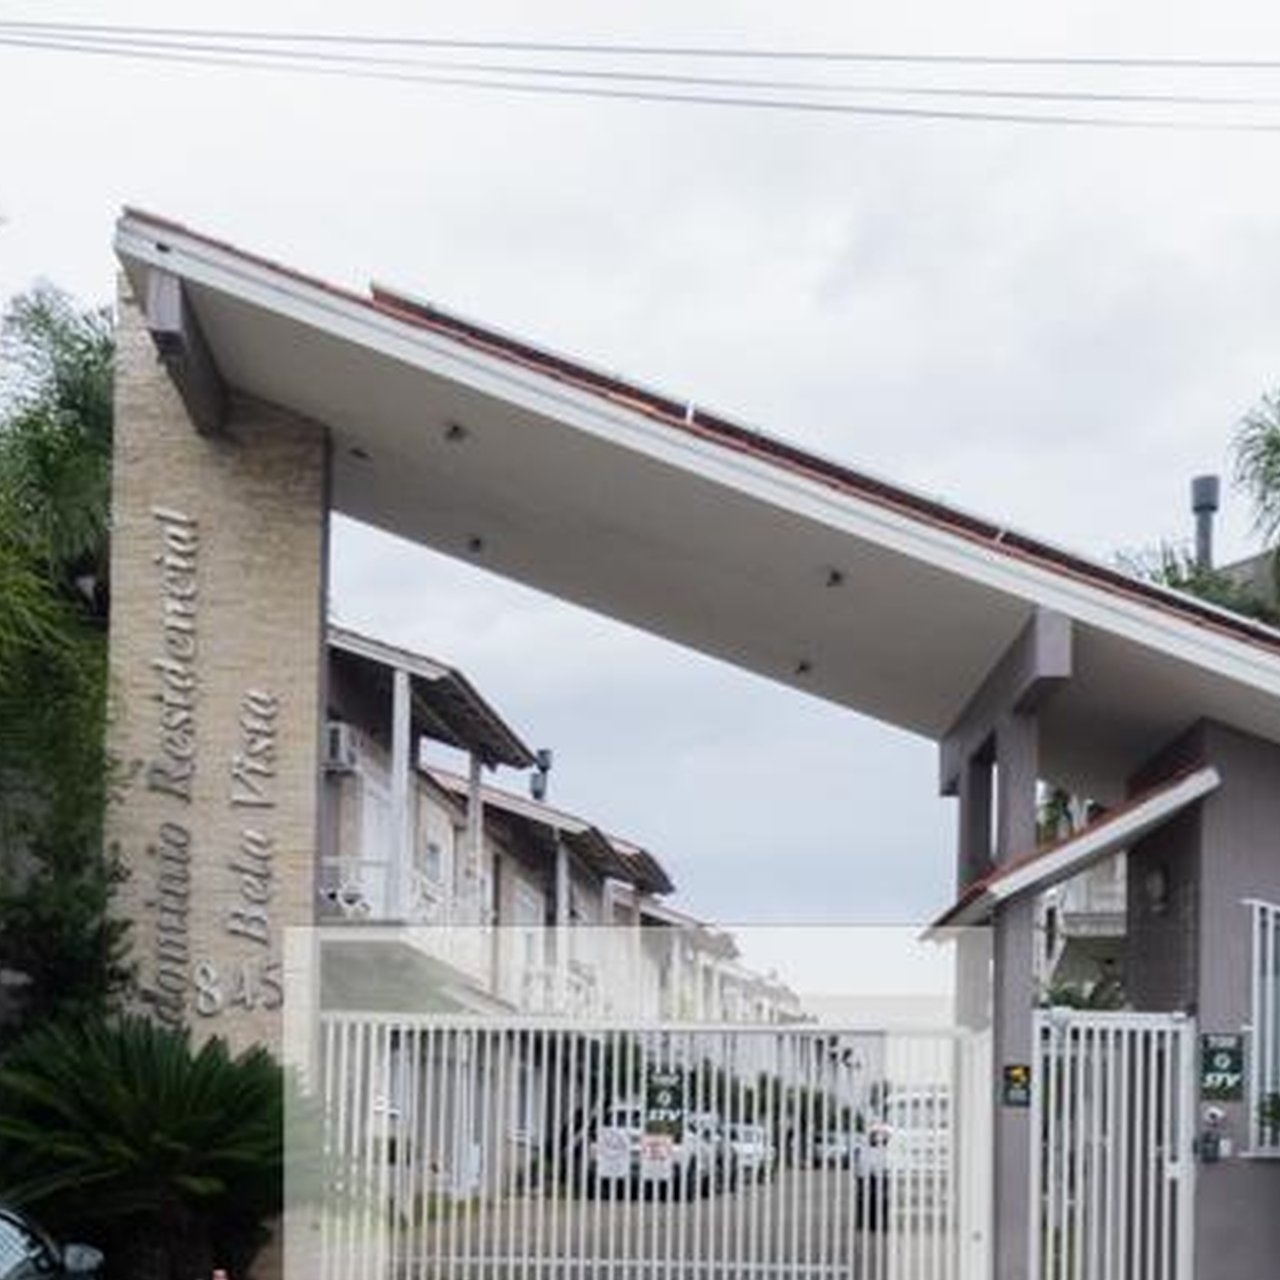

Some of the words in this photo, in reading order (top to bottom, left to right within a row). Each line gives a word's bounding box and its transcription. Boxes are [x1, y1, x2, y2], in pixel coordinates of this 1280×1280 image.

[149, 507, 200, 803] Residencial
[230, 688, 280, 810] Vista
[228, 829, 276, 947] Bela
